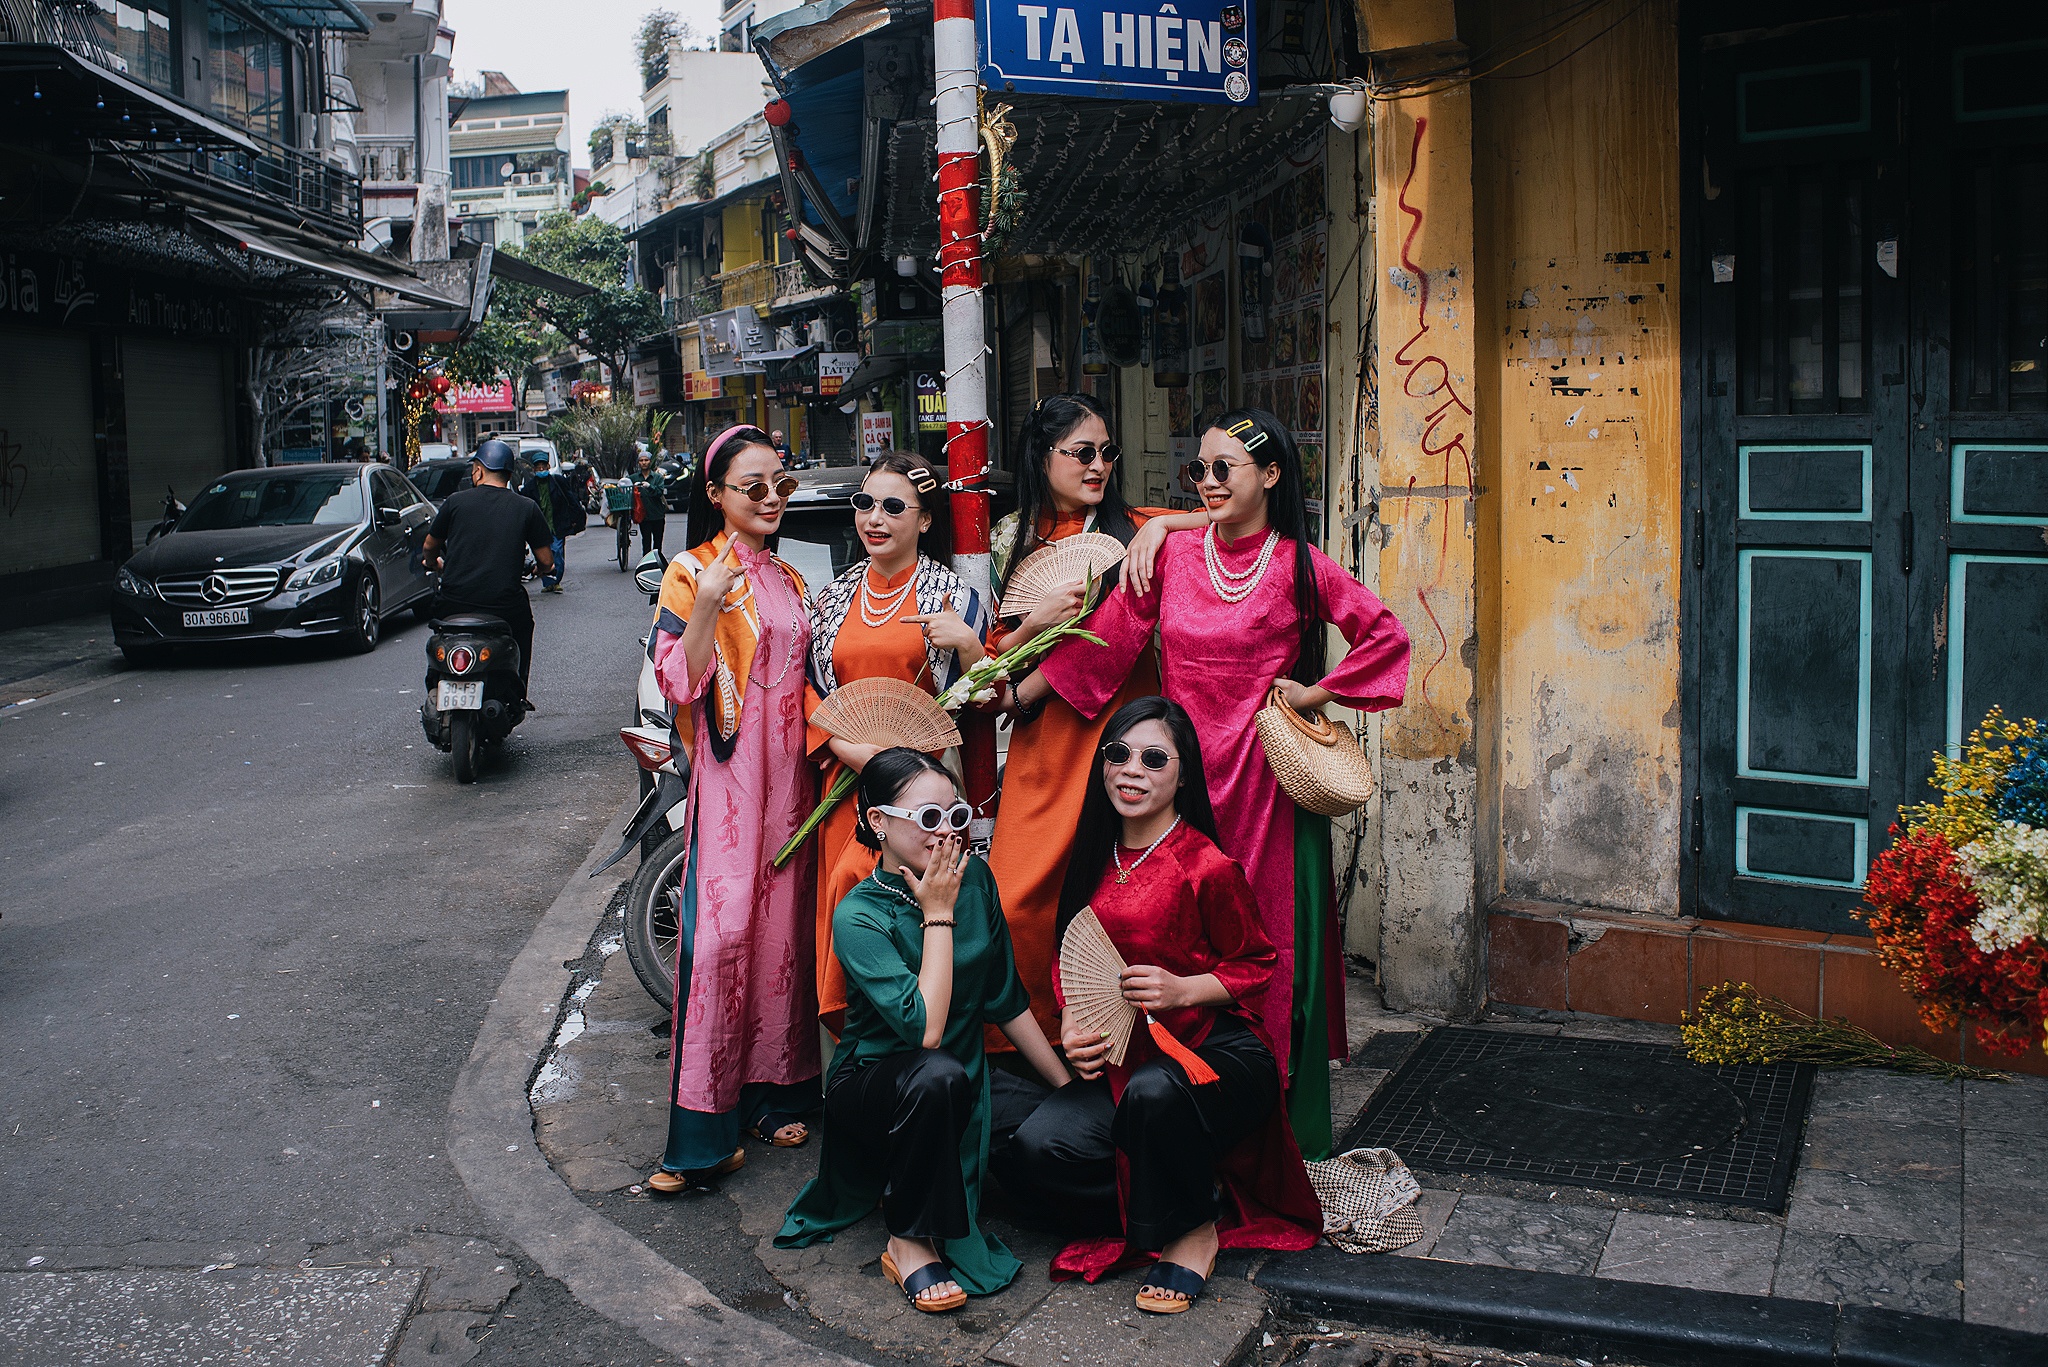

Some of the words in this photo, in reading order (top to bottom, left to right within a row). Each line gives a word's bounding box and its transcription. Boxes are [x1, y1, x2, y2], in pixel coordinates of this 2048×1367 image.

[1017, 4, 1085, 74] TẠ
[1102, 3, 1221, 81] HIỆN
[917, 373, 940, 390] Ca
[935, 414, 947, 422] AW
[865, 430, 875, 444] CÁ
[185, 612, 247, 625] 30A-966.04
[444, 695, 476, 707] 8697
